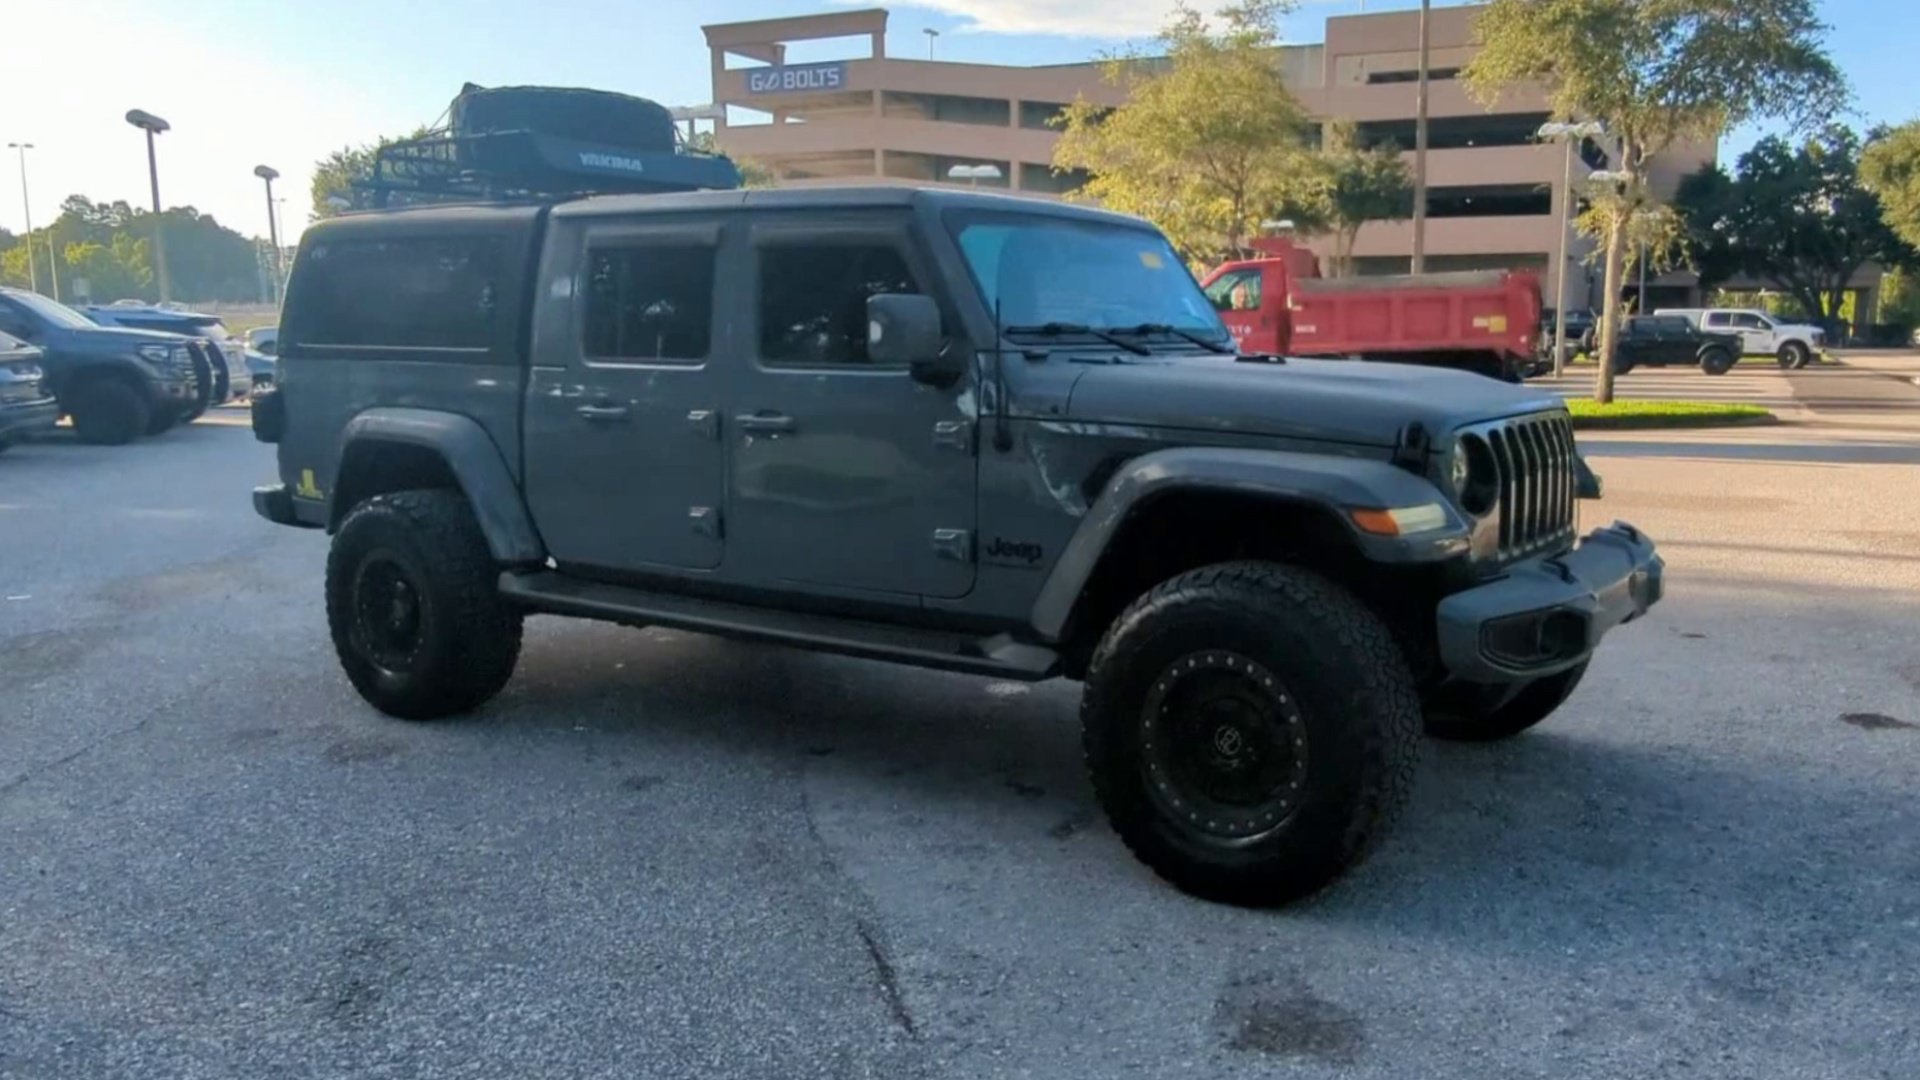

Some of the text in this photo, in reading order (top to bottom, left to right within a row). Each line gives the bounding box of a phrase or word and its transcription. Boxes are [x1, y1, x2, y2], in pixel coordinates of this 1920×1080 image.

[751, 67, 839, 91] GO BOLTS
[579, 153, 643, 171] YAKIMA
[986, 537, 1042, 563] Jeep
